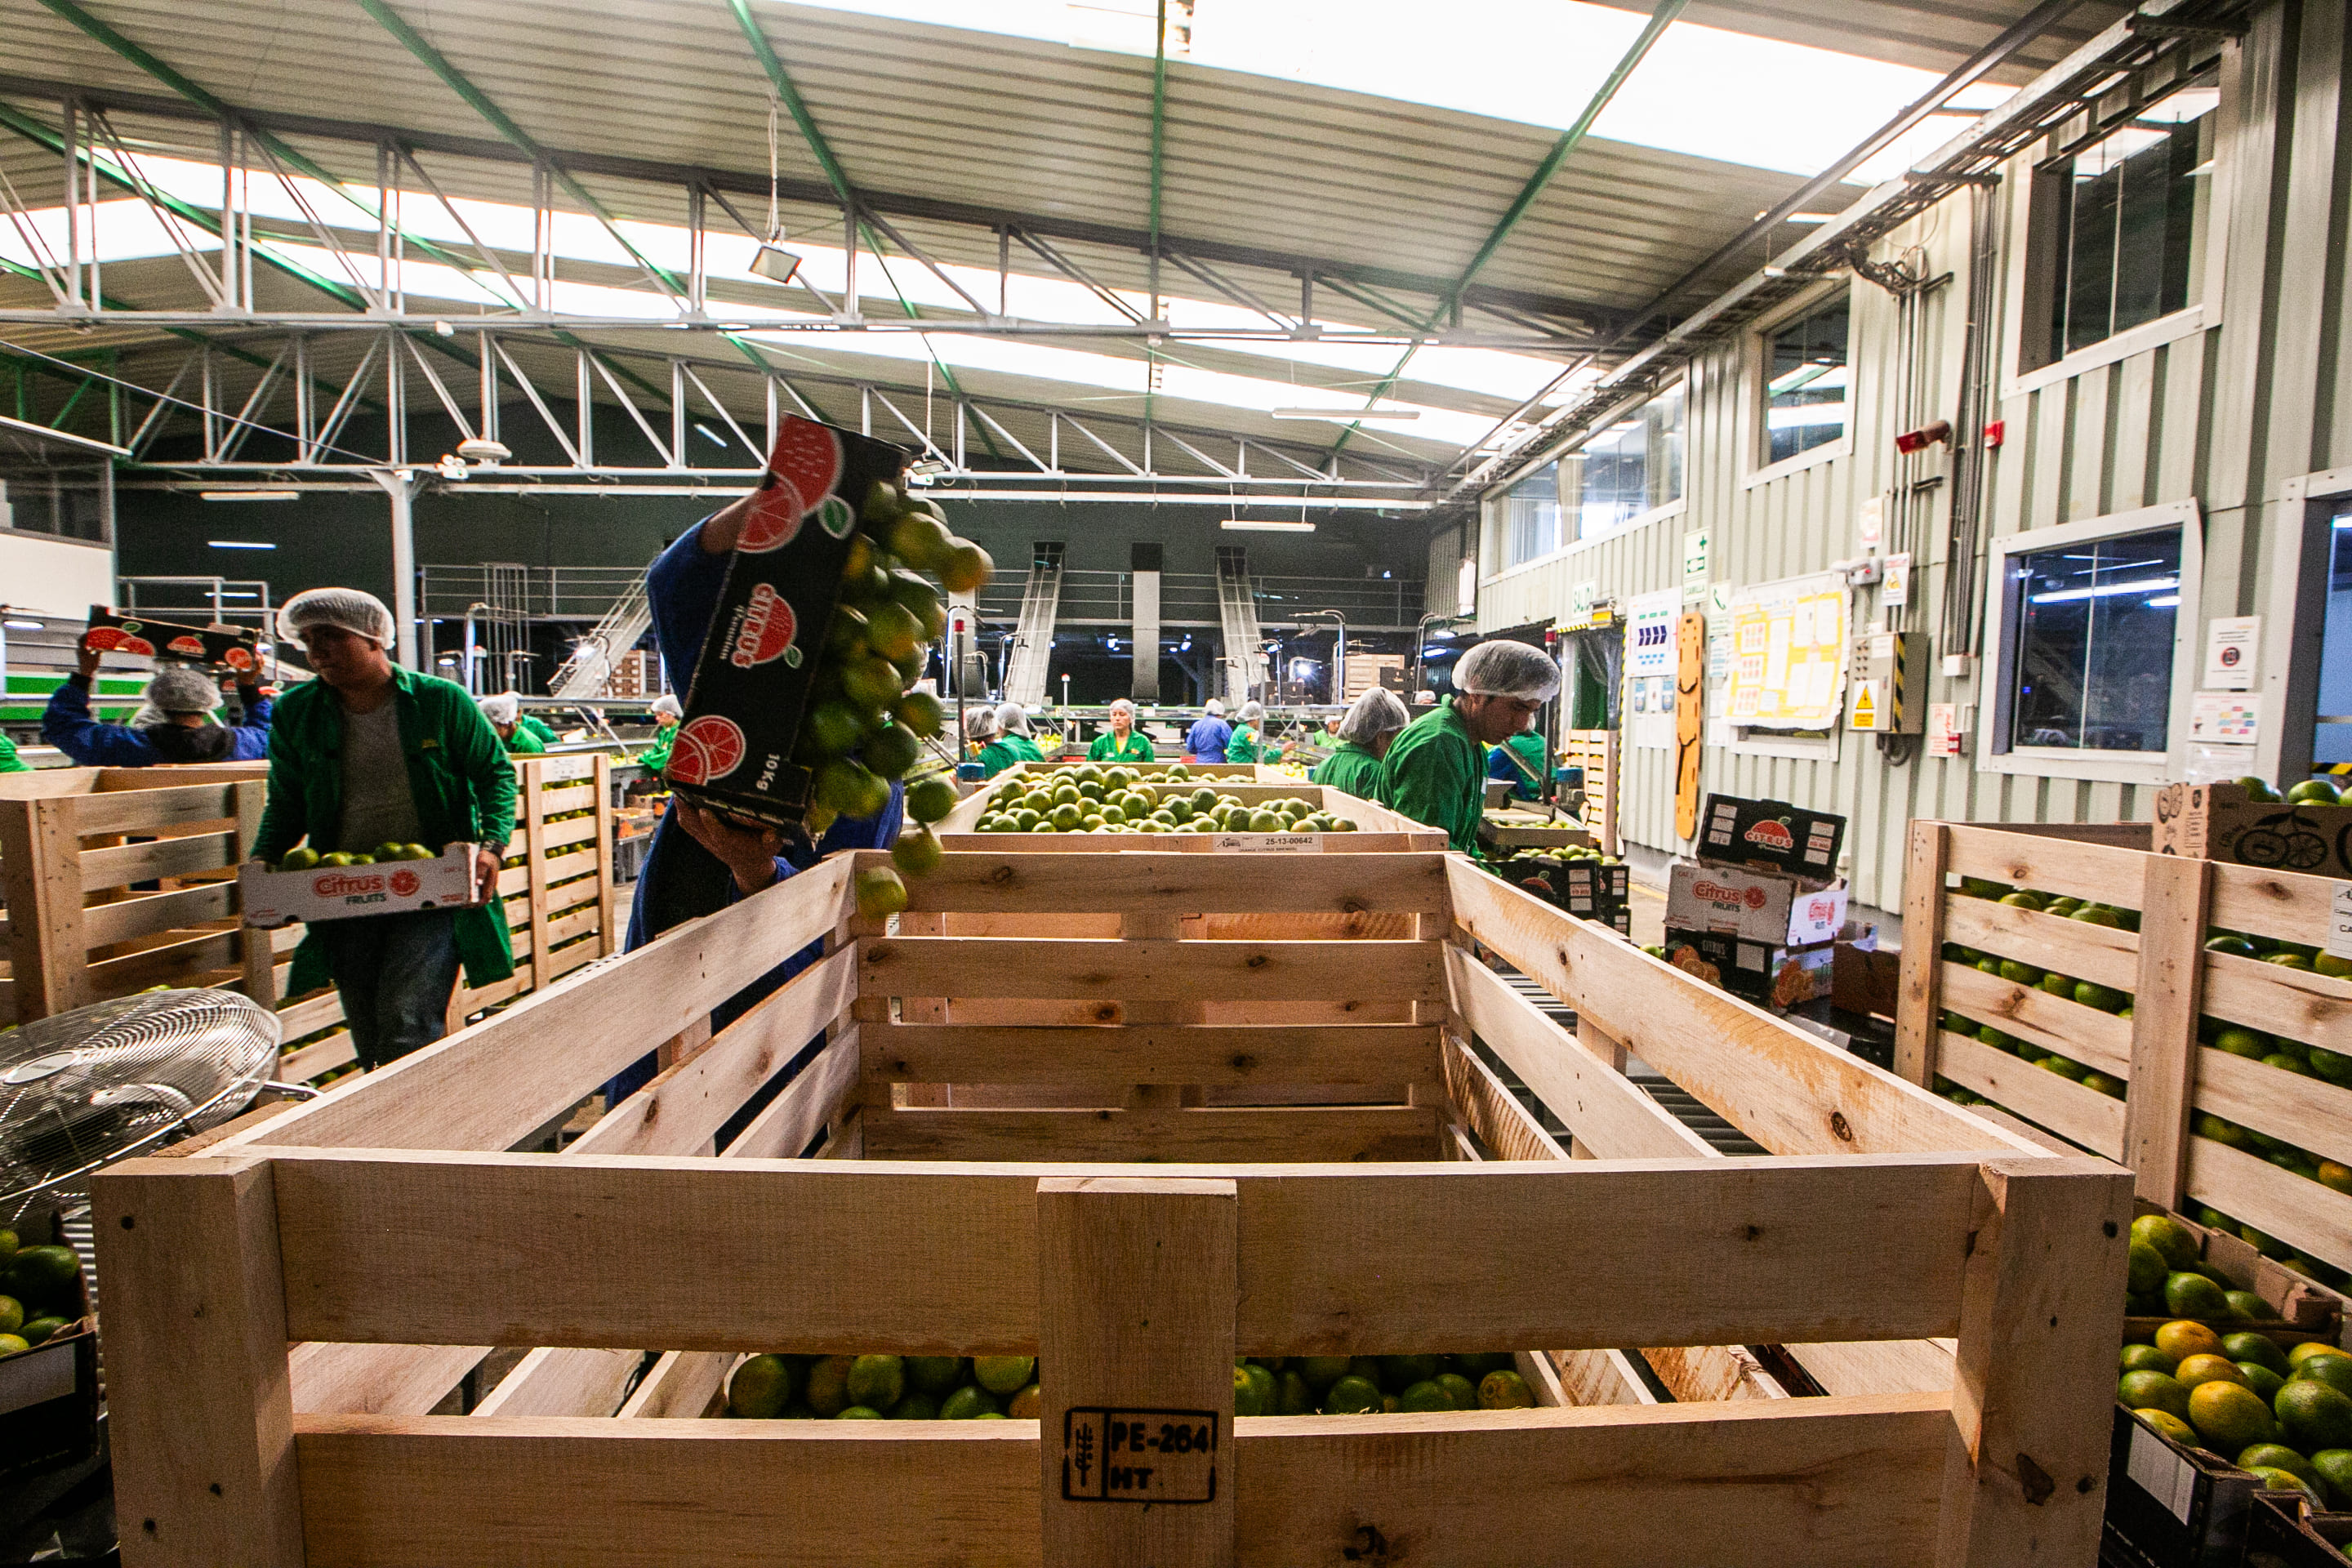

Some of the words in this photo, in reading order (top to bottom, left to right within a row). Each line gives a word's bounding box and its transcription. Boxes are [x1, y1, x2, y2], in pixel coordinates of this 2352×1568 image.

[732, 583, 777, 668] CITRUS
[1744, 831, 1793, 849] CITRUS
[314, 874, 385, 897] Citrus
[1693, 880, 1743, 904] Citrus
[1712, 901, 1741, 912] FRUITS
[1111, 1422, 1208, 1453] PE-264
[1111, 1468, 1153, 1489] HT
